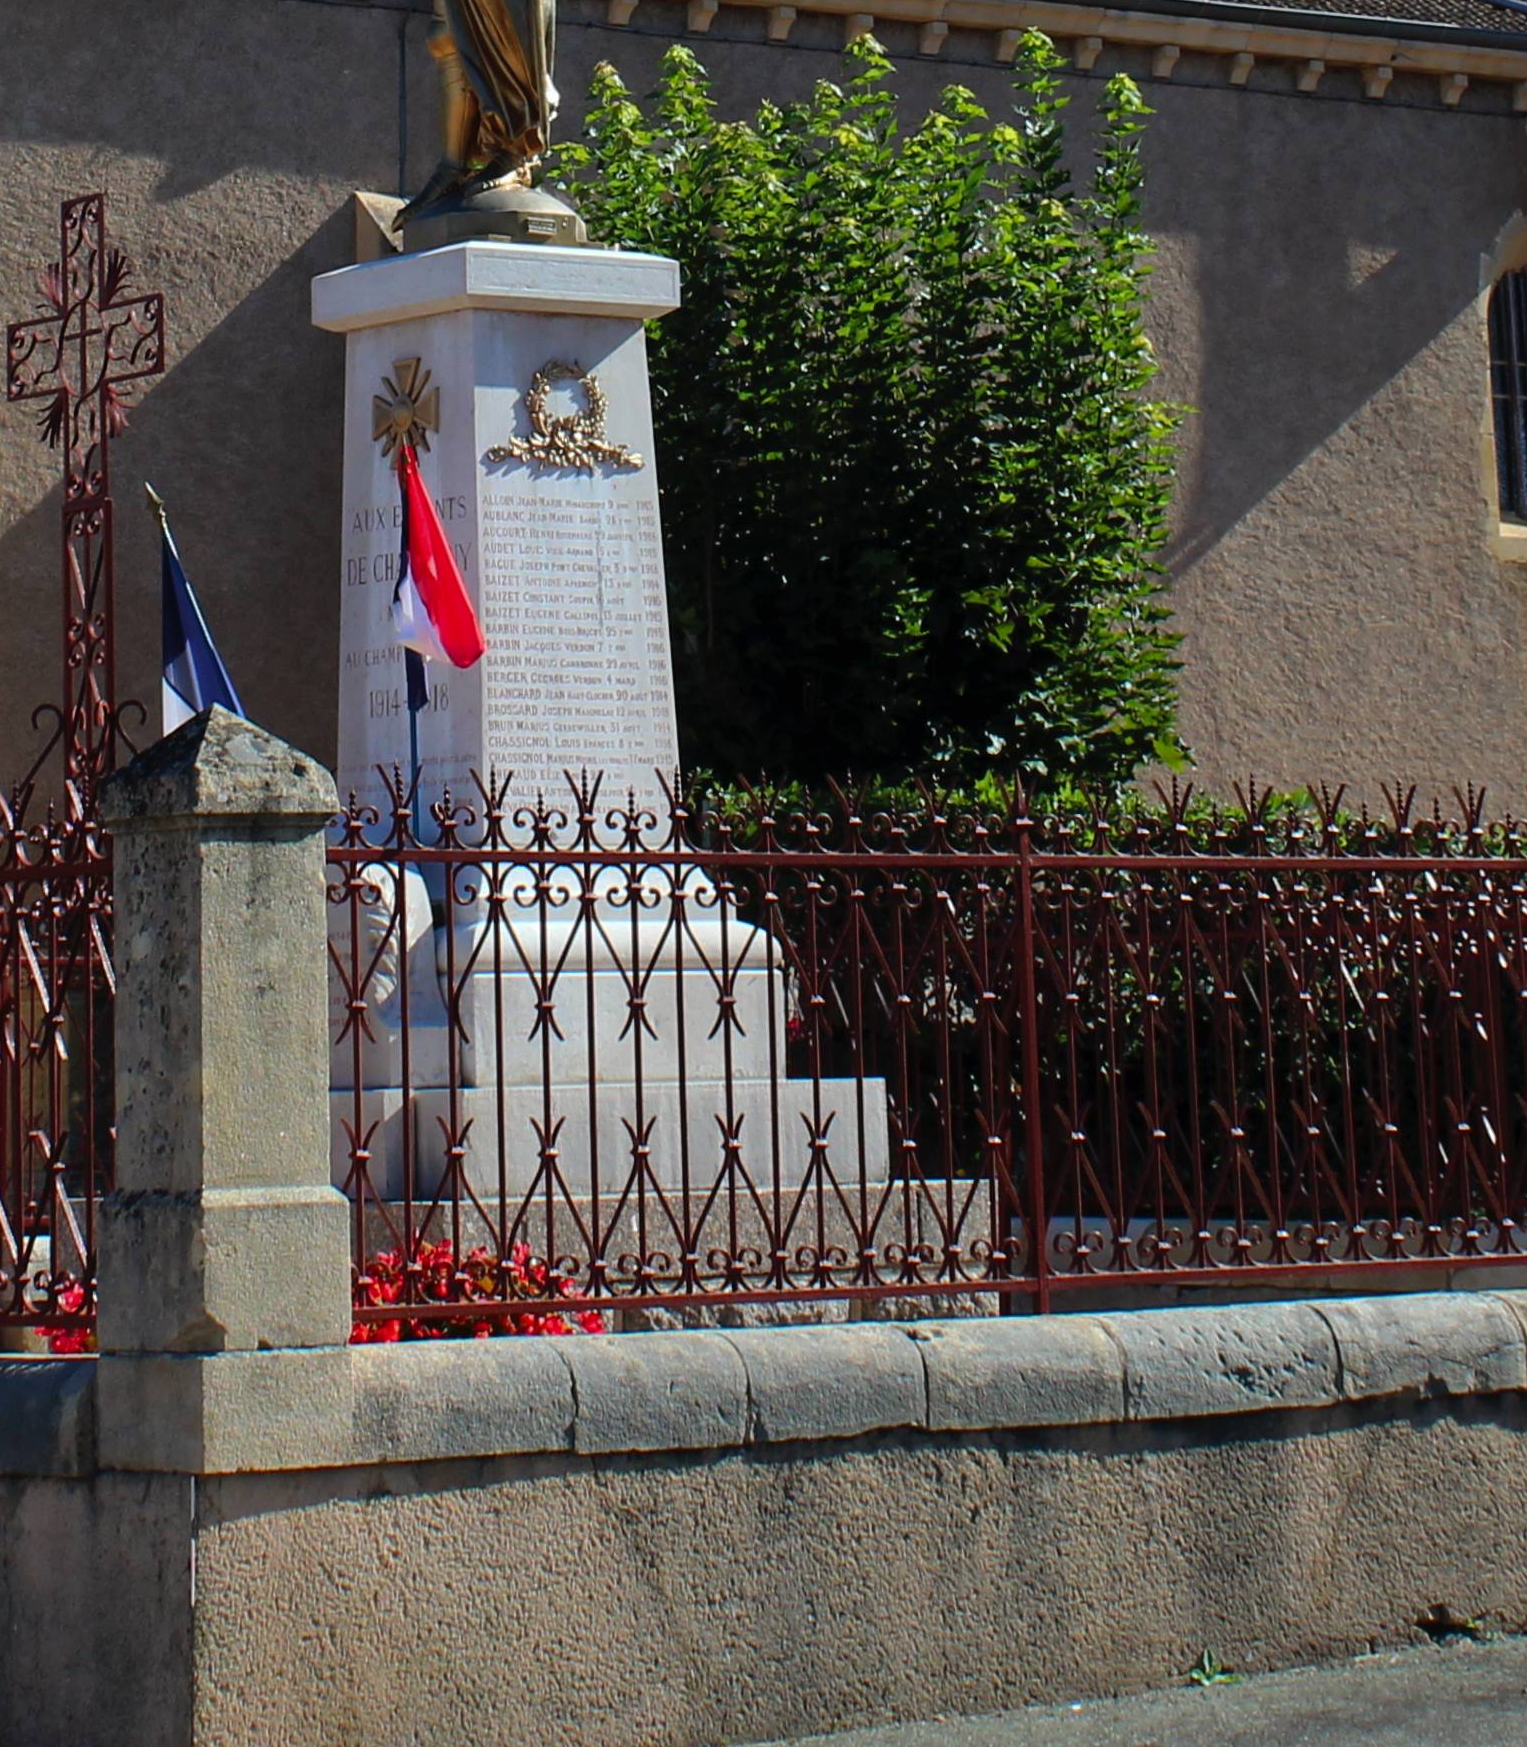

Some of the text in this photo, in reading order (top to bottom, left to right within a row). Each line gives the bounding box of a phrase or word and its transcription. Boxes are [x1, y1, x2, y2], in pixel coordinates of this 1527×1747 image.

[352, 507, 386, 534] AUX
[484, 542, 515, 555] AUDET
[347, 556, 367, 587] DE
[485, 574, 520, 587] BAIZET
[485, 590, 520, 603] BAIZET
[485, 607, 520, 619] BAIZET
[346, 652, 362, 669] AU
[487, 671, 528, 683] BERGER
[487, 687, 541, 700] BLANCHARD
[487, 703, 538, 716] BROSSARD
[541, 704, 574, 717] JOSEPH
[488, 720, 515, 732] BRUN
[488, 735, 550, 748] CHASSIGNOL
[555, 736, 581, 748] LOUIS
[489, 752, 544, 764] CHASSIGNOL
